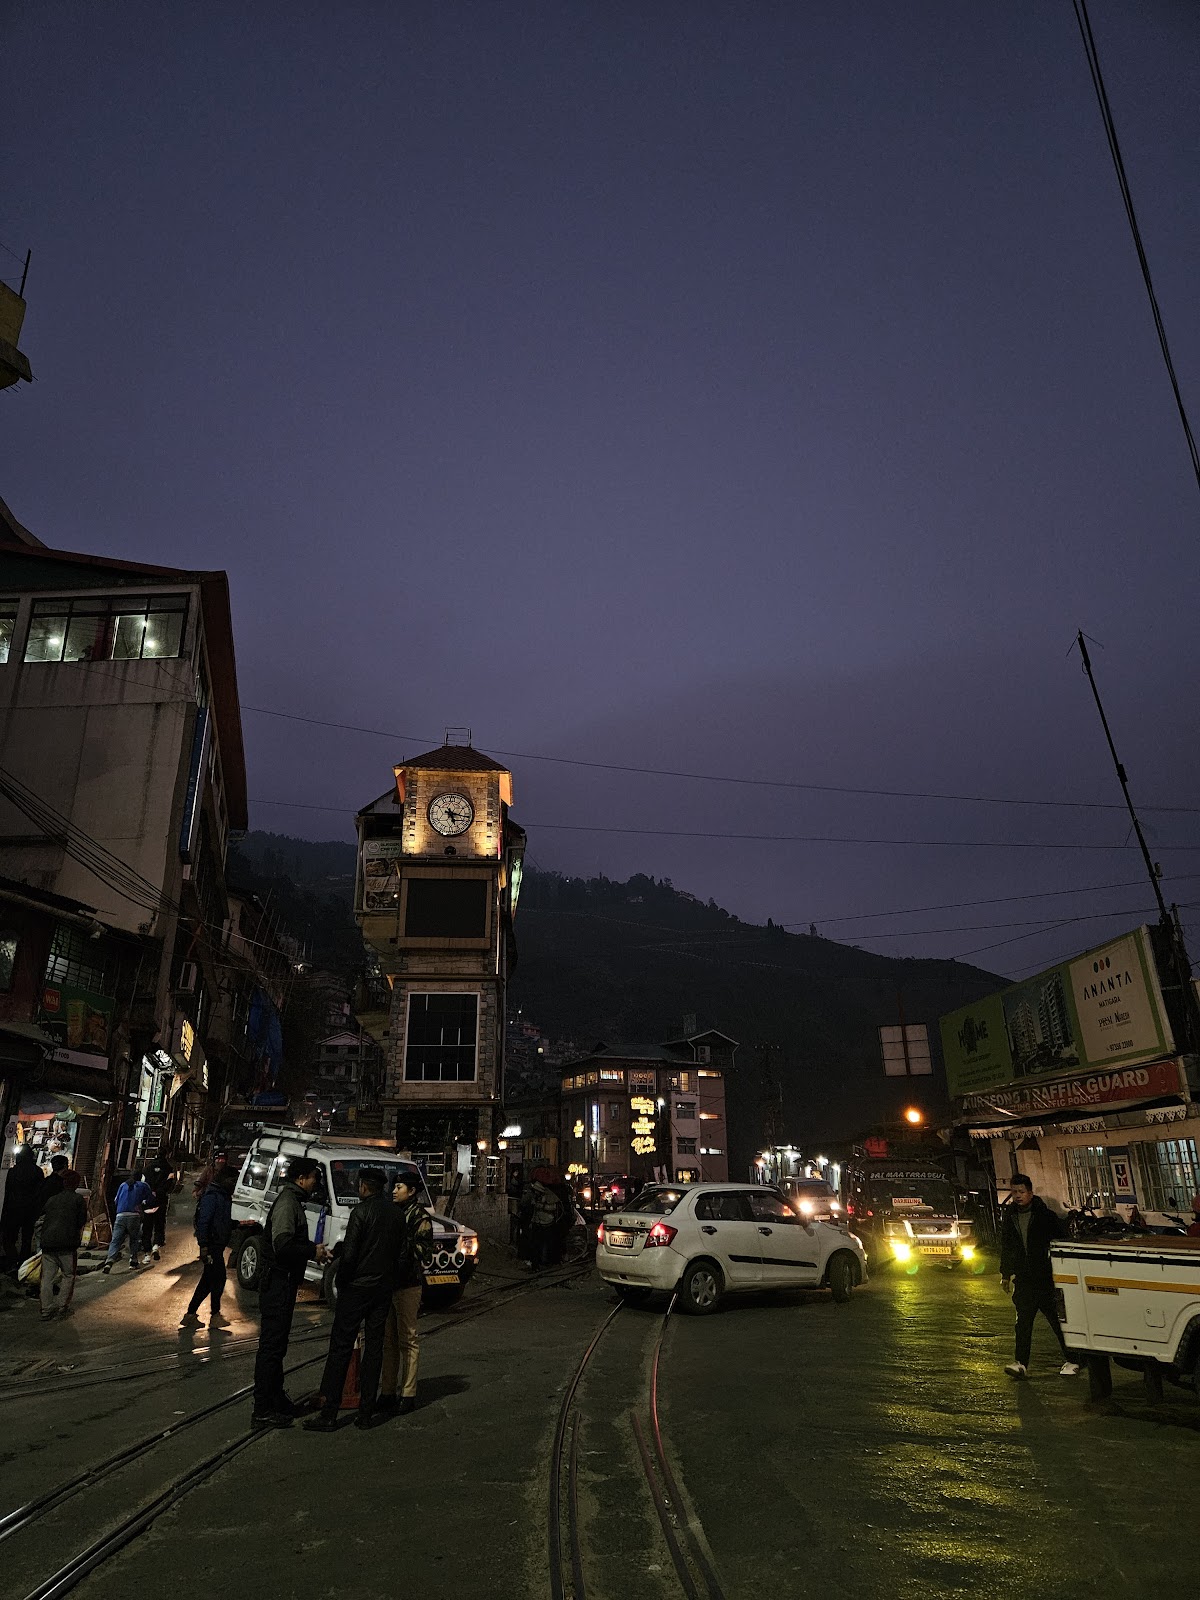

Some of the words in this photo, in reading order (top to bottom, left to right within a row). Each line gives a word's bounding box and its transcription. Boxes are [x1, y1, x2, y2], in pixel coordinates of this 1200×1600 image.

[1083, 970, 1132, 1001] ANANTA
[1098, 996, 1122, 1009] MATIGARA
[1086, 1068, 1150, 1094] GUARD
[1067, 1093, 1102, 1106] POLICE
